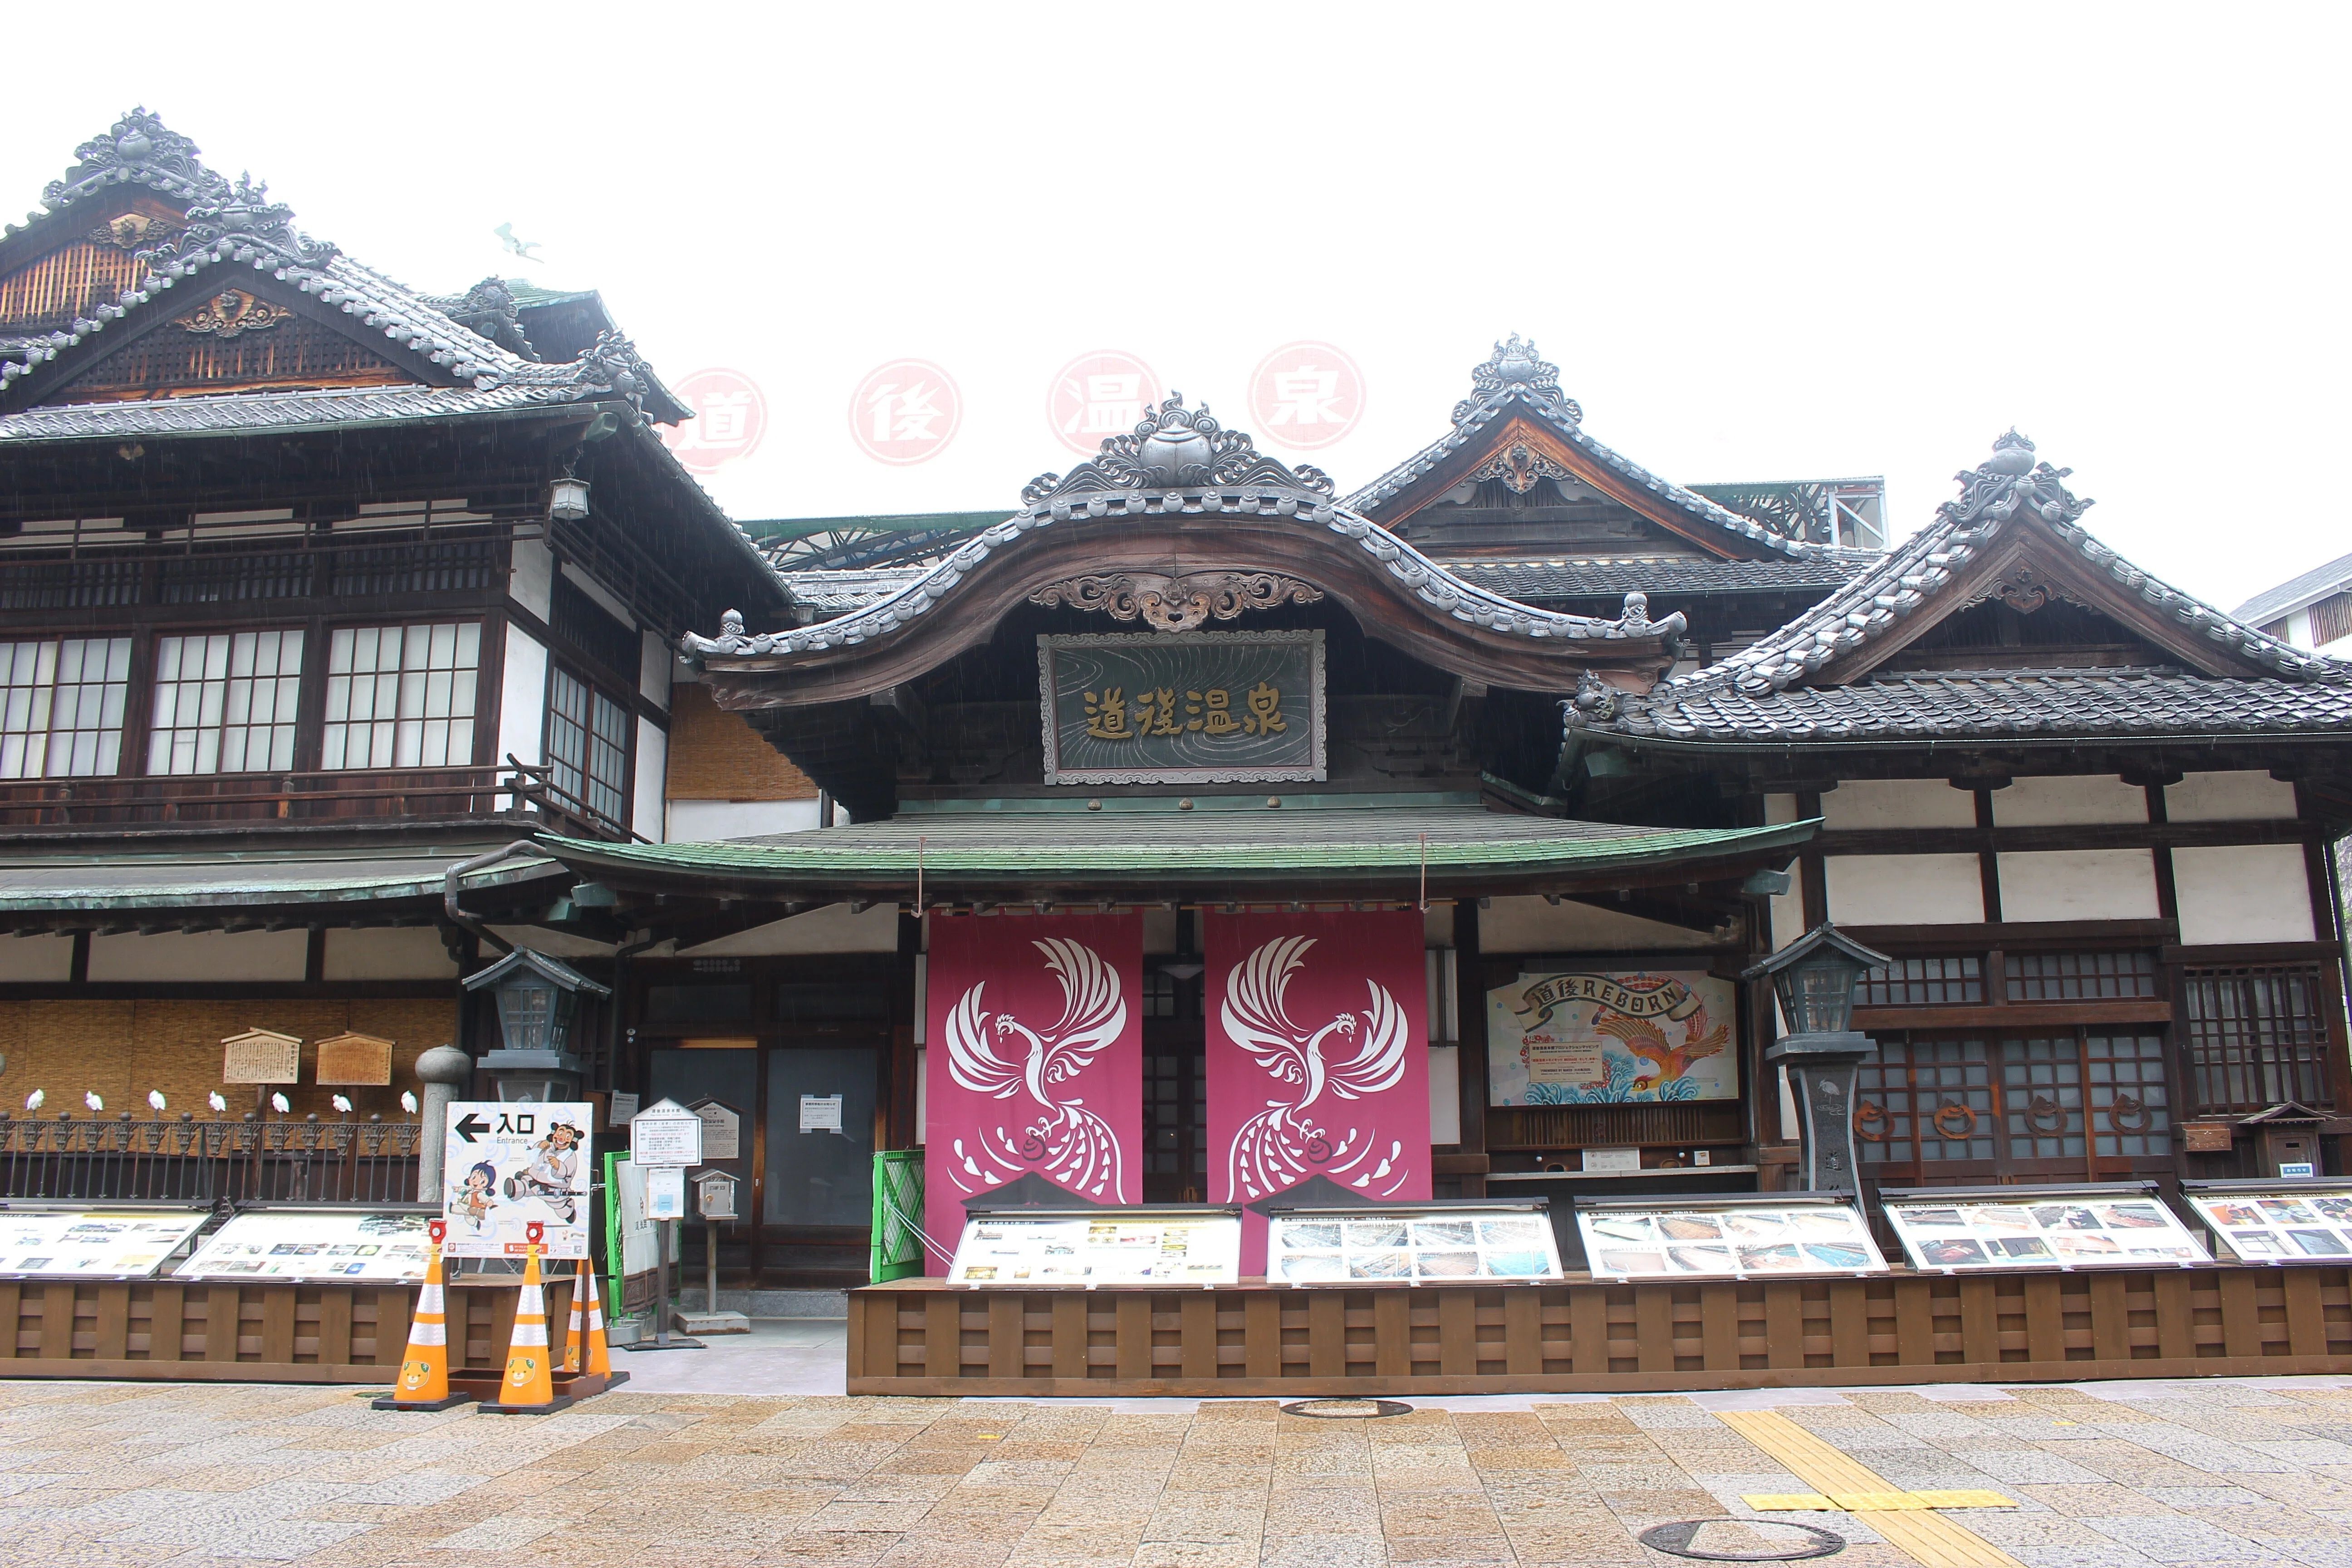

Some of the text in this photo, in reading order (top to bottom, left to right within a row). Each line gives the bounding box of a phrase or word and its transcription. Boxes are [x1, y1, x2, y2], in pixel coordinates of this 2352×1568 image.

[1084, 681, 1288, 740] 道後温泉
[1531, 978, 1678, 1013] 道後REBORN
[496, 1113, 534, 1135] 入口
